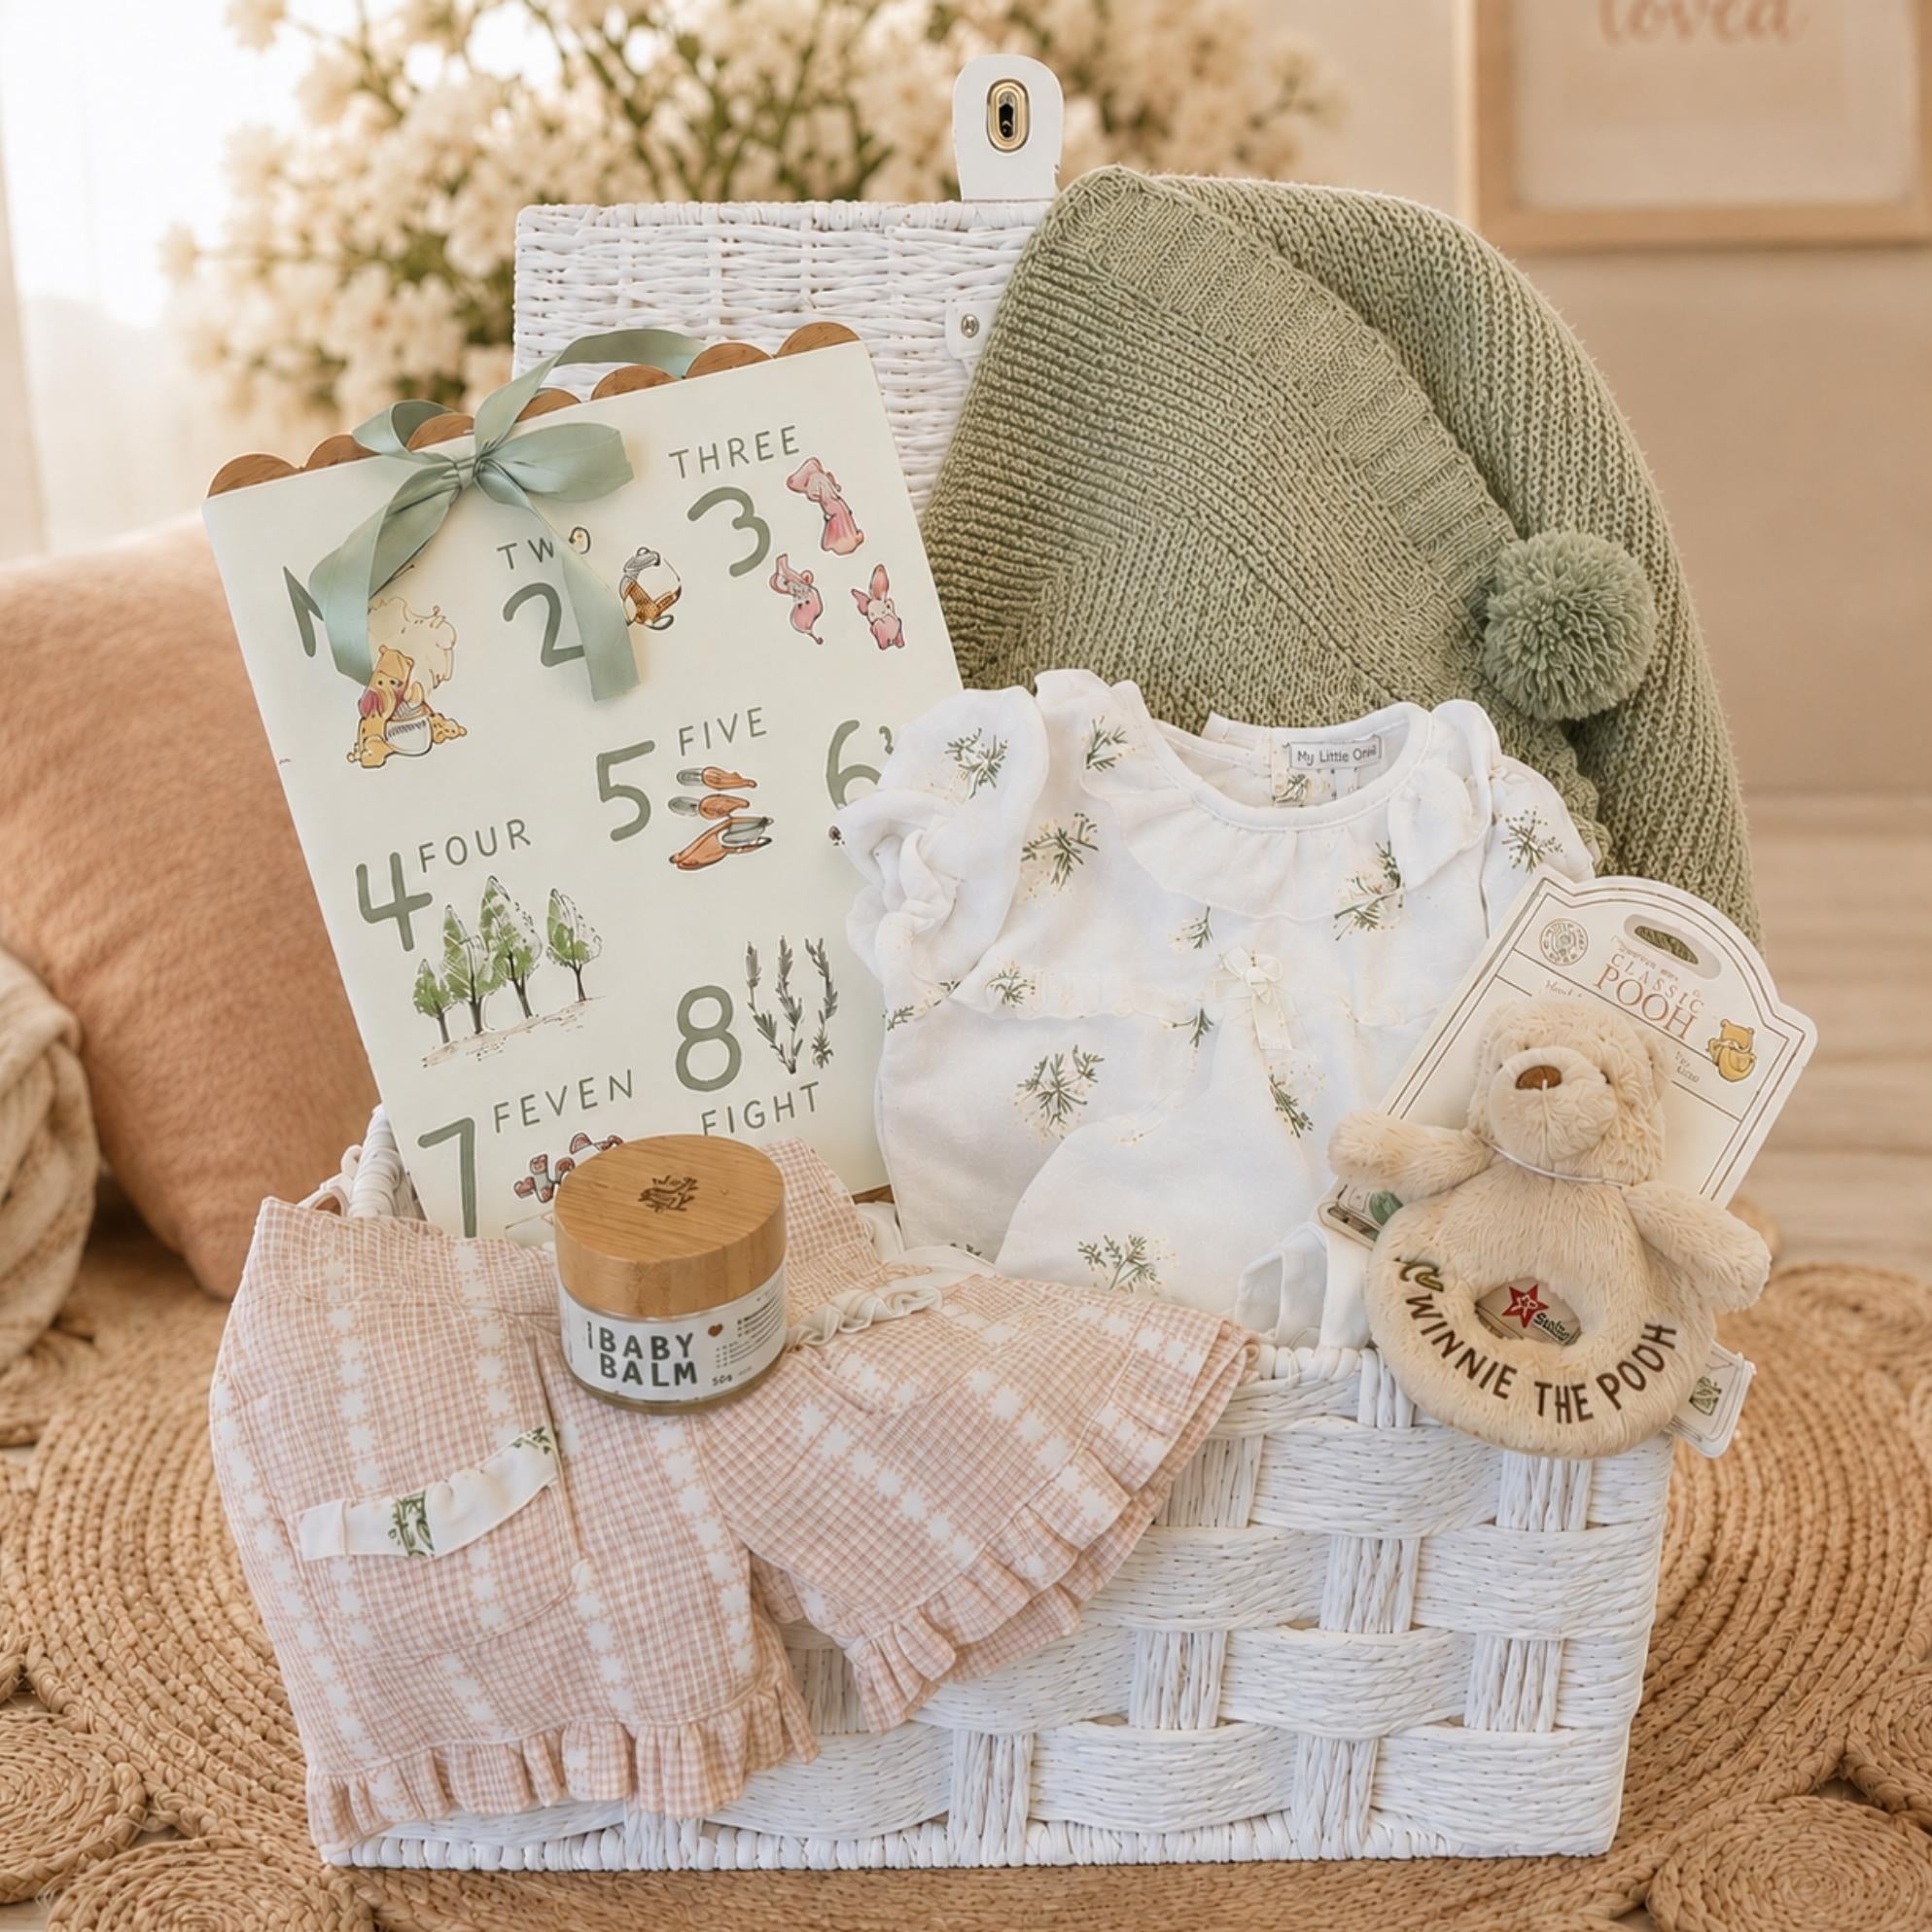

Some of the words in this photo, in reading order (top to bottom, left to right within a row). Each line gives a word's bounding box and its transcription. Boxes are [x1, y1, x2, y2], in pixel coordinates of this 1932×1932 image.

[668, 425, 799, 478] THREE
[686, 486, 771, 578] 3
[503, 581, 585, 668] 2
[679, 707, 767, 756] FIVE
[825, 720, 882, 811] 6
[1297, 747, 1316, 766] My
[1319, 749, 1350, 763] Little
[596, 739, 656, 842] 5
[418, 819, 531, 873] FOUR
[355, 852, 434, 952] 4
[1593, 964, 1699, 1040] POOH
[1610, 952, 1704, 1014] CLASSIC
[676, 985, 742, 1092] 8
[494, 1069, 634, 1133] FEVEN
[417, 1117, 477, 1239] 7
[599, 1326, 694, 1360] BABY
[599, 1352, 698, 1388] BALM
[1405, 1293, 1518, 1400] WINNIE
[1533, 1381, 1595, 1424] THE
